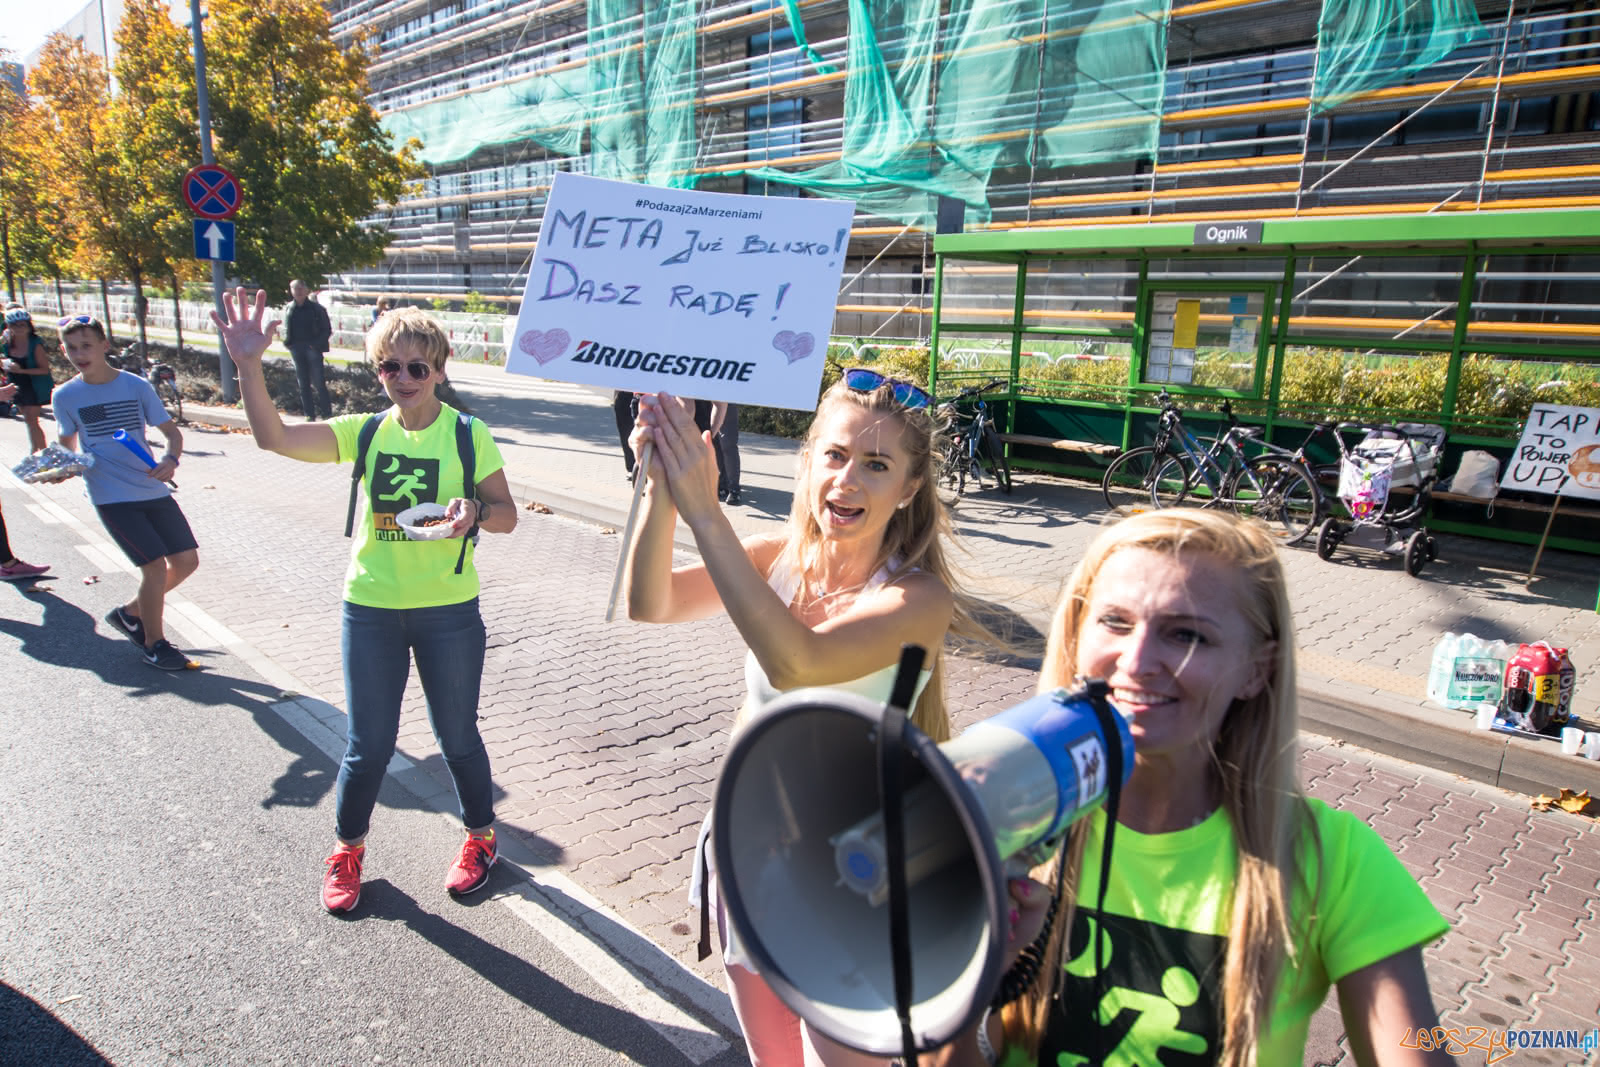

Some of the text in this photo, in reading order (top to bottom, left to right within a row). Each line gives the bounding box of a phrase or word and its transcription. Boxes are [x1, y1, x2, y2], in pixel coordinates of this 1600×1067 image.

[635, 199, 763, 220] #PodazajZaMarzeniami
[547, 209, 664, 250] META
[1206, 226, 1248, 244] Ognik
[571, 340, 757, 382] BRIDGESTONE
[1534, 409, 1589, 433] TAP
[1533, 433, 1566, 448] TO
[1520, 445, 1571, 464] POWER
[1513, 463, 1570, 494] UP!
